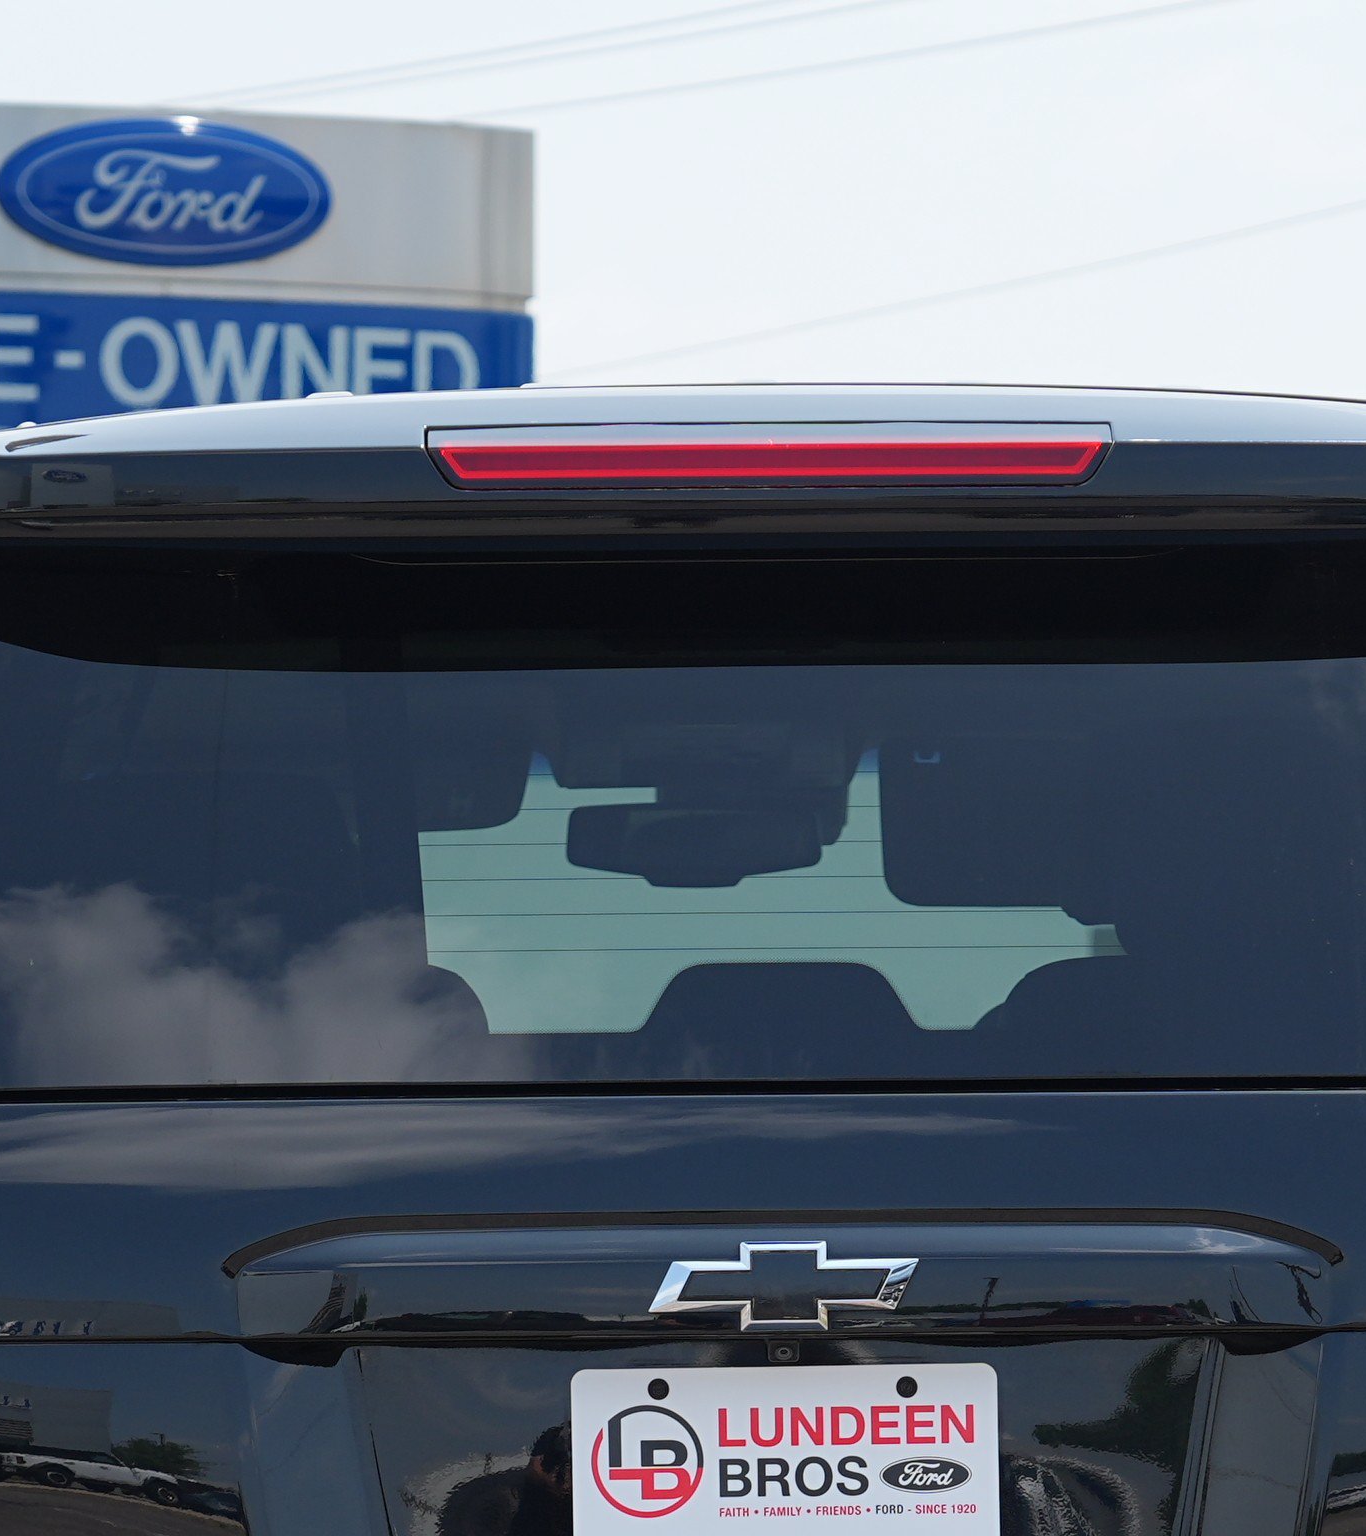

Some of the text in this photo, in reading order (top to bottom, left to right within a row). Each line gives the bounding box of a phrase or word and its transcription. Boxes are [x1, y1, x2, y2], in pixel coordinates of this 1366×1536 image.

[75, 148, 267, 233] Ford
[718, 1404, 975, 1447] LUNDEEN
[719, 1456, 954, 1498] BROS Ford
[719, 1503, 977, 1518] FAITH FAMILY FRIENDS FORD SINCE 1920
